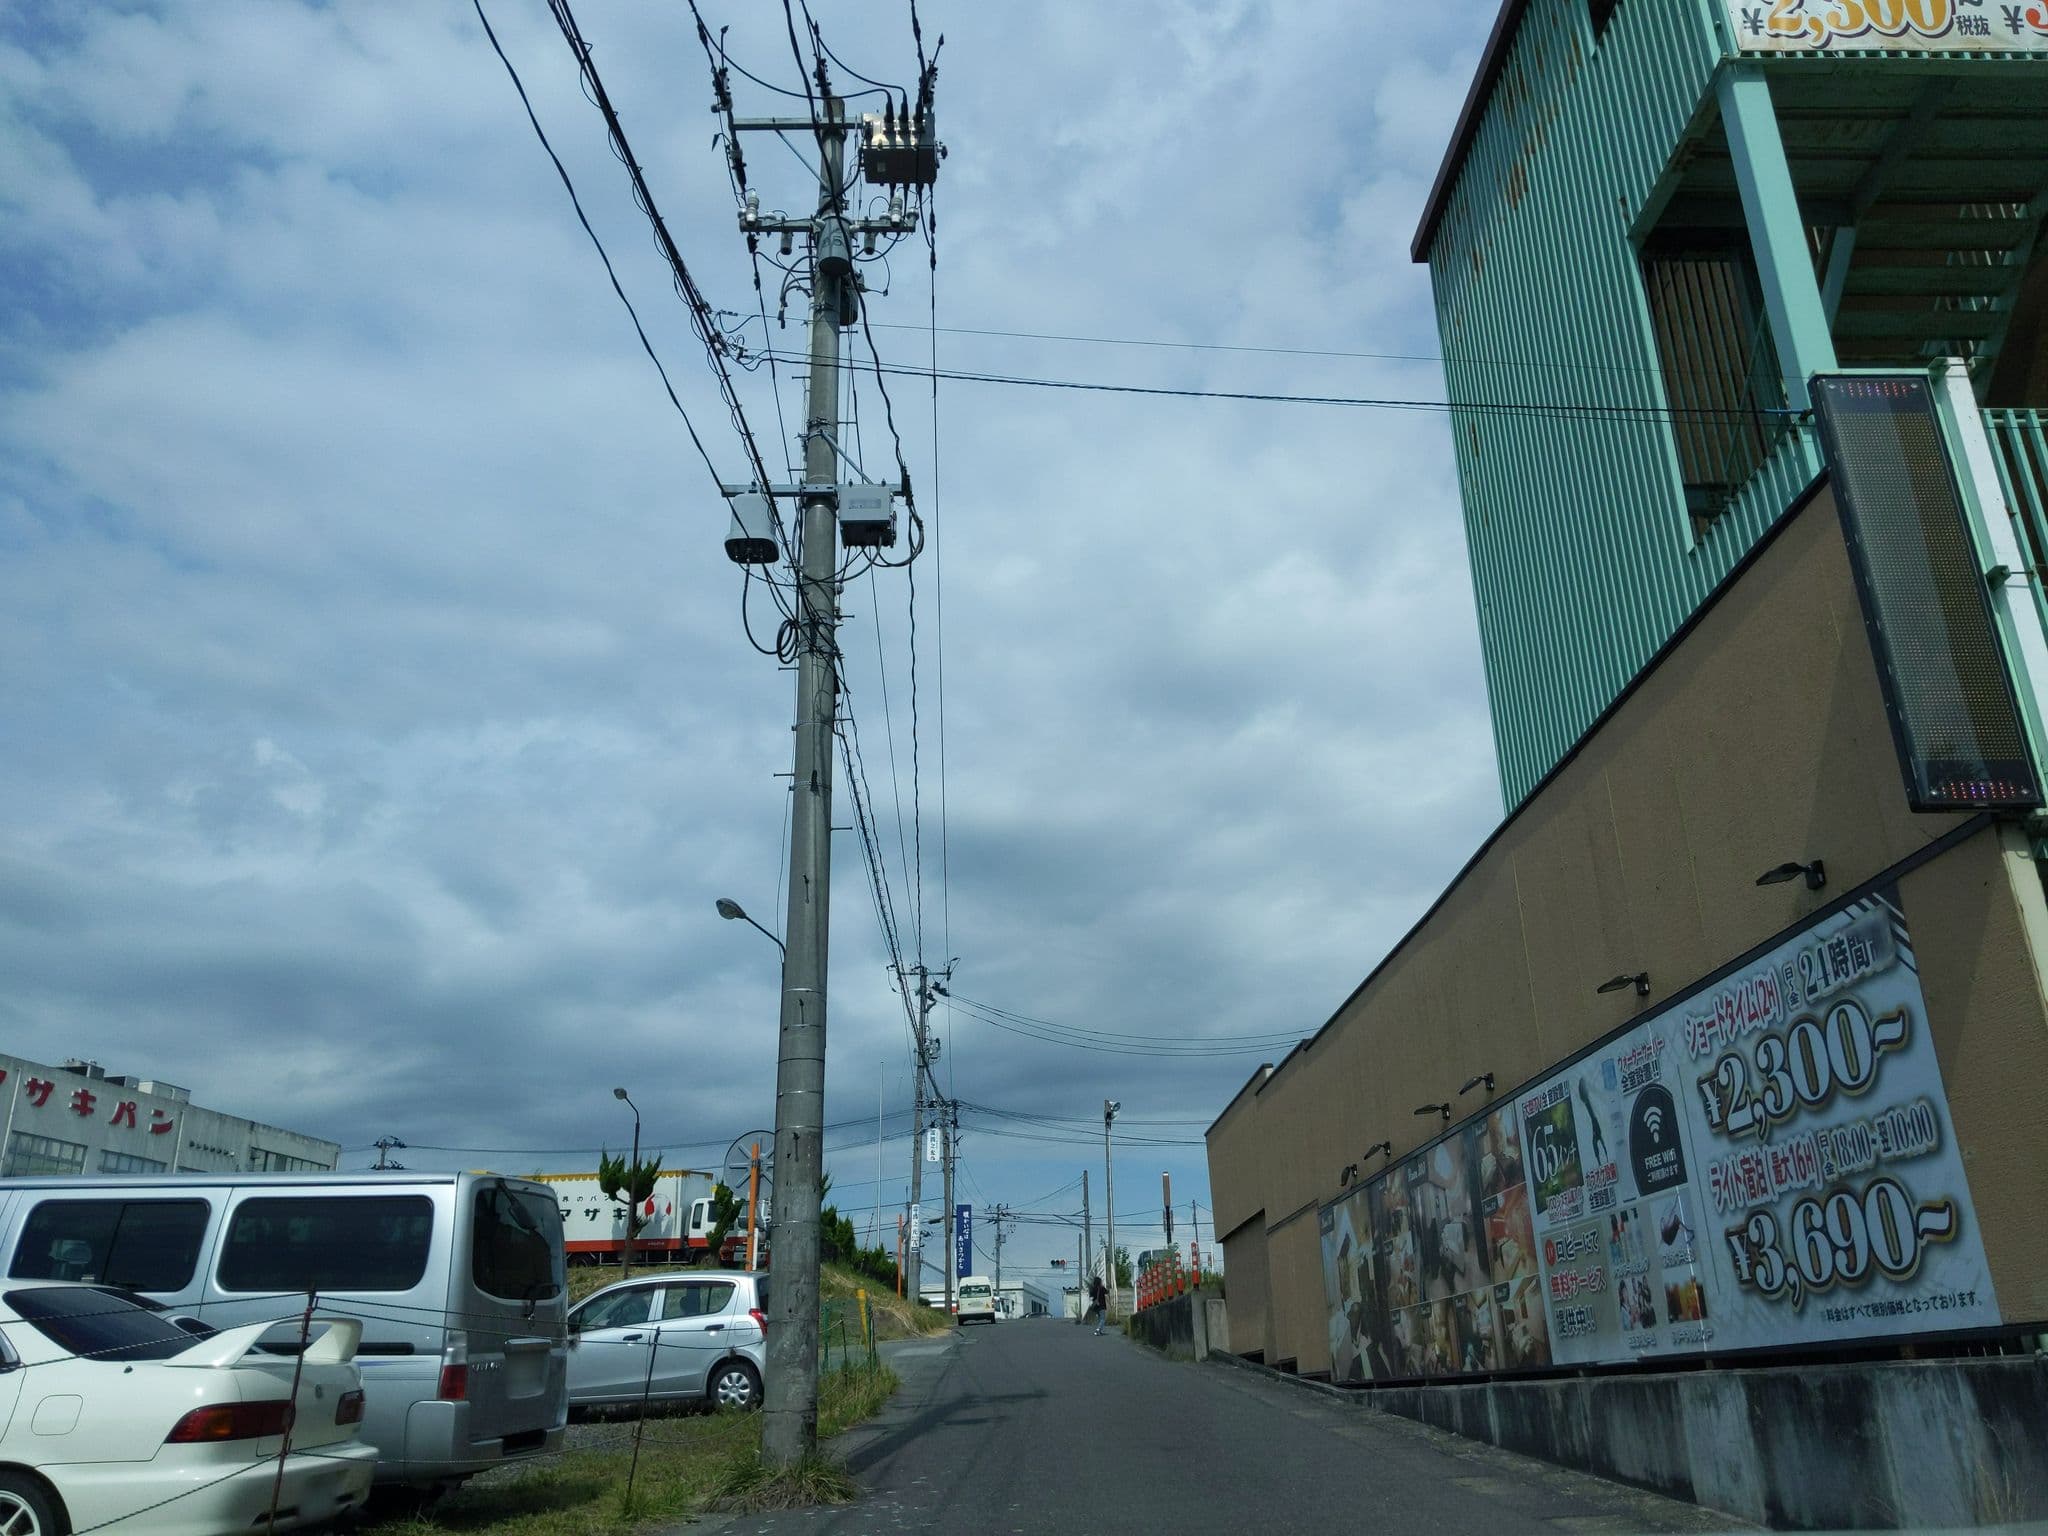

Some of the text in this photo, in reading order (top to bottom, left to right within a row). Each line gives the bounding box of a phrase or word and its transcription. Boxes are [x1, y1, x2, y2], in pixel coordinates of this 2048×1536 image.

[1956, 15, 1991, 36] 税抜
[0, 1070, 173, 1135] サキパン
[1644, 1153, 1662, 1169] FREE
